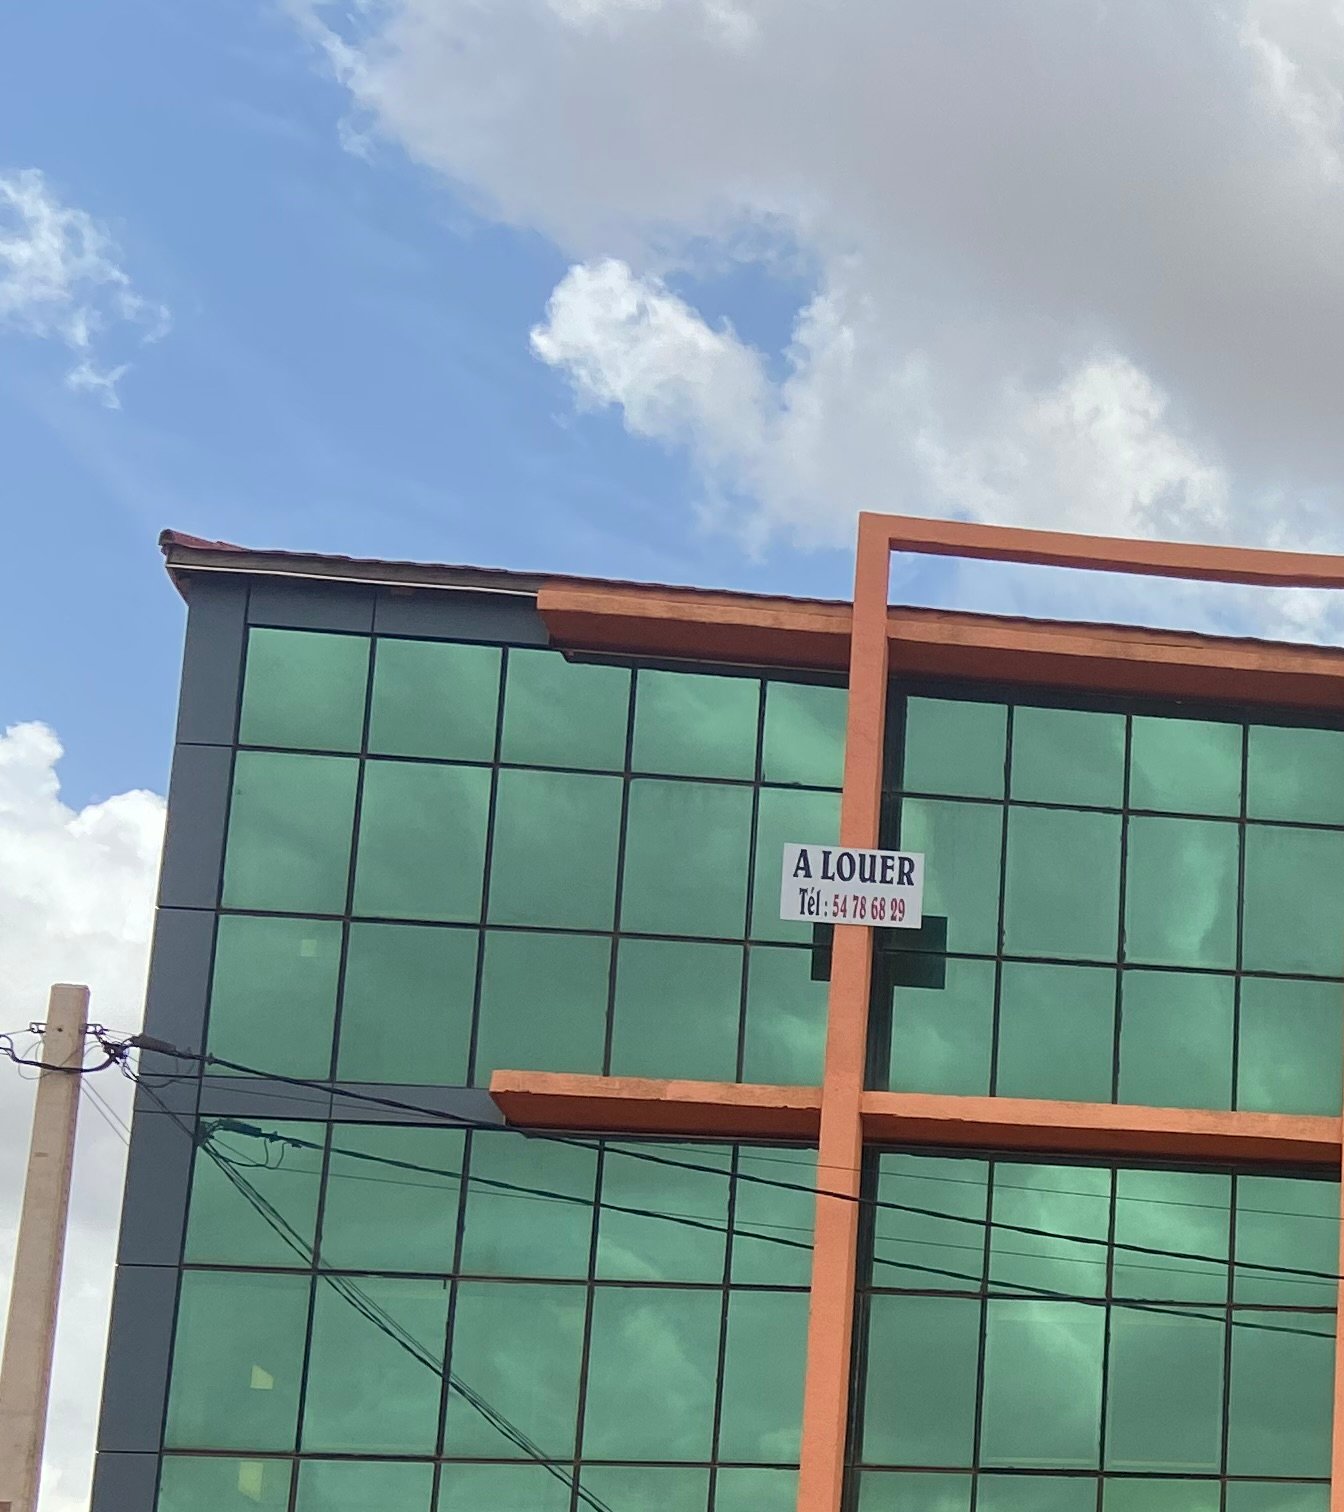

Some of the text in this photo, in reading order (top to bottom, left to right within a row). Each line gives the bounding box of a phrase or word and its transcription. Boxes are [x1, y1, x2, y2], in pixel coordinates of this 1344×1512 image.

[793, 848, 915, 886] A LOUER
[832, 893, 847, 918] 54
[852, 894, 867, 919] 78
[871, 896, 885, 920] 68
[890, 898, 905, 922] 29
